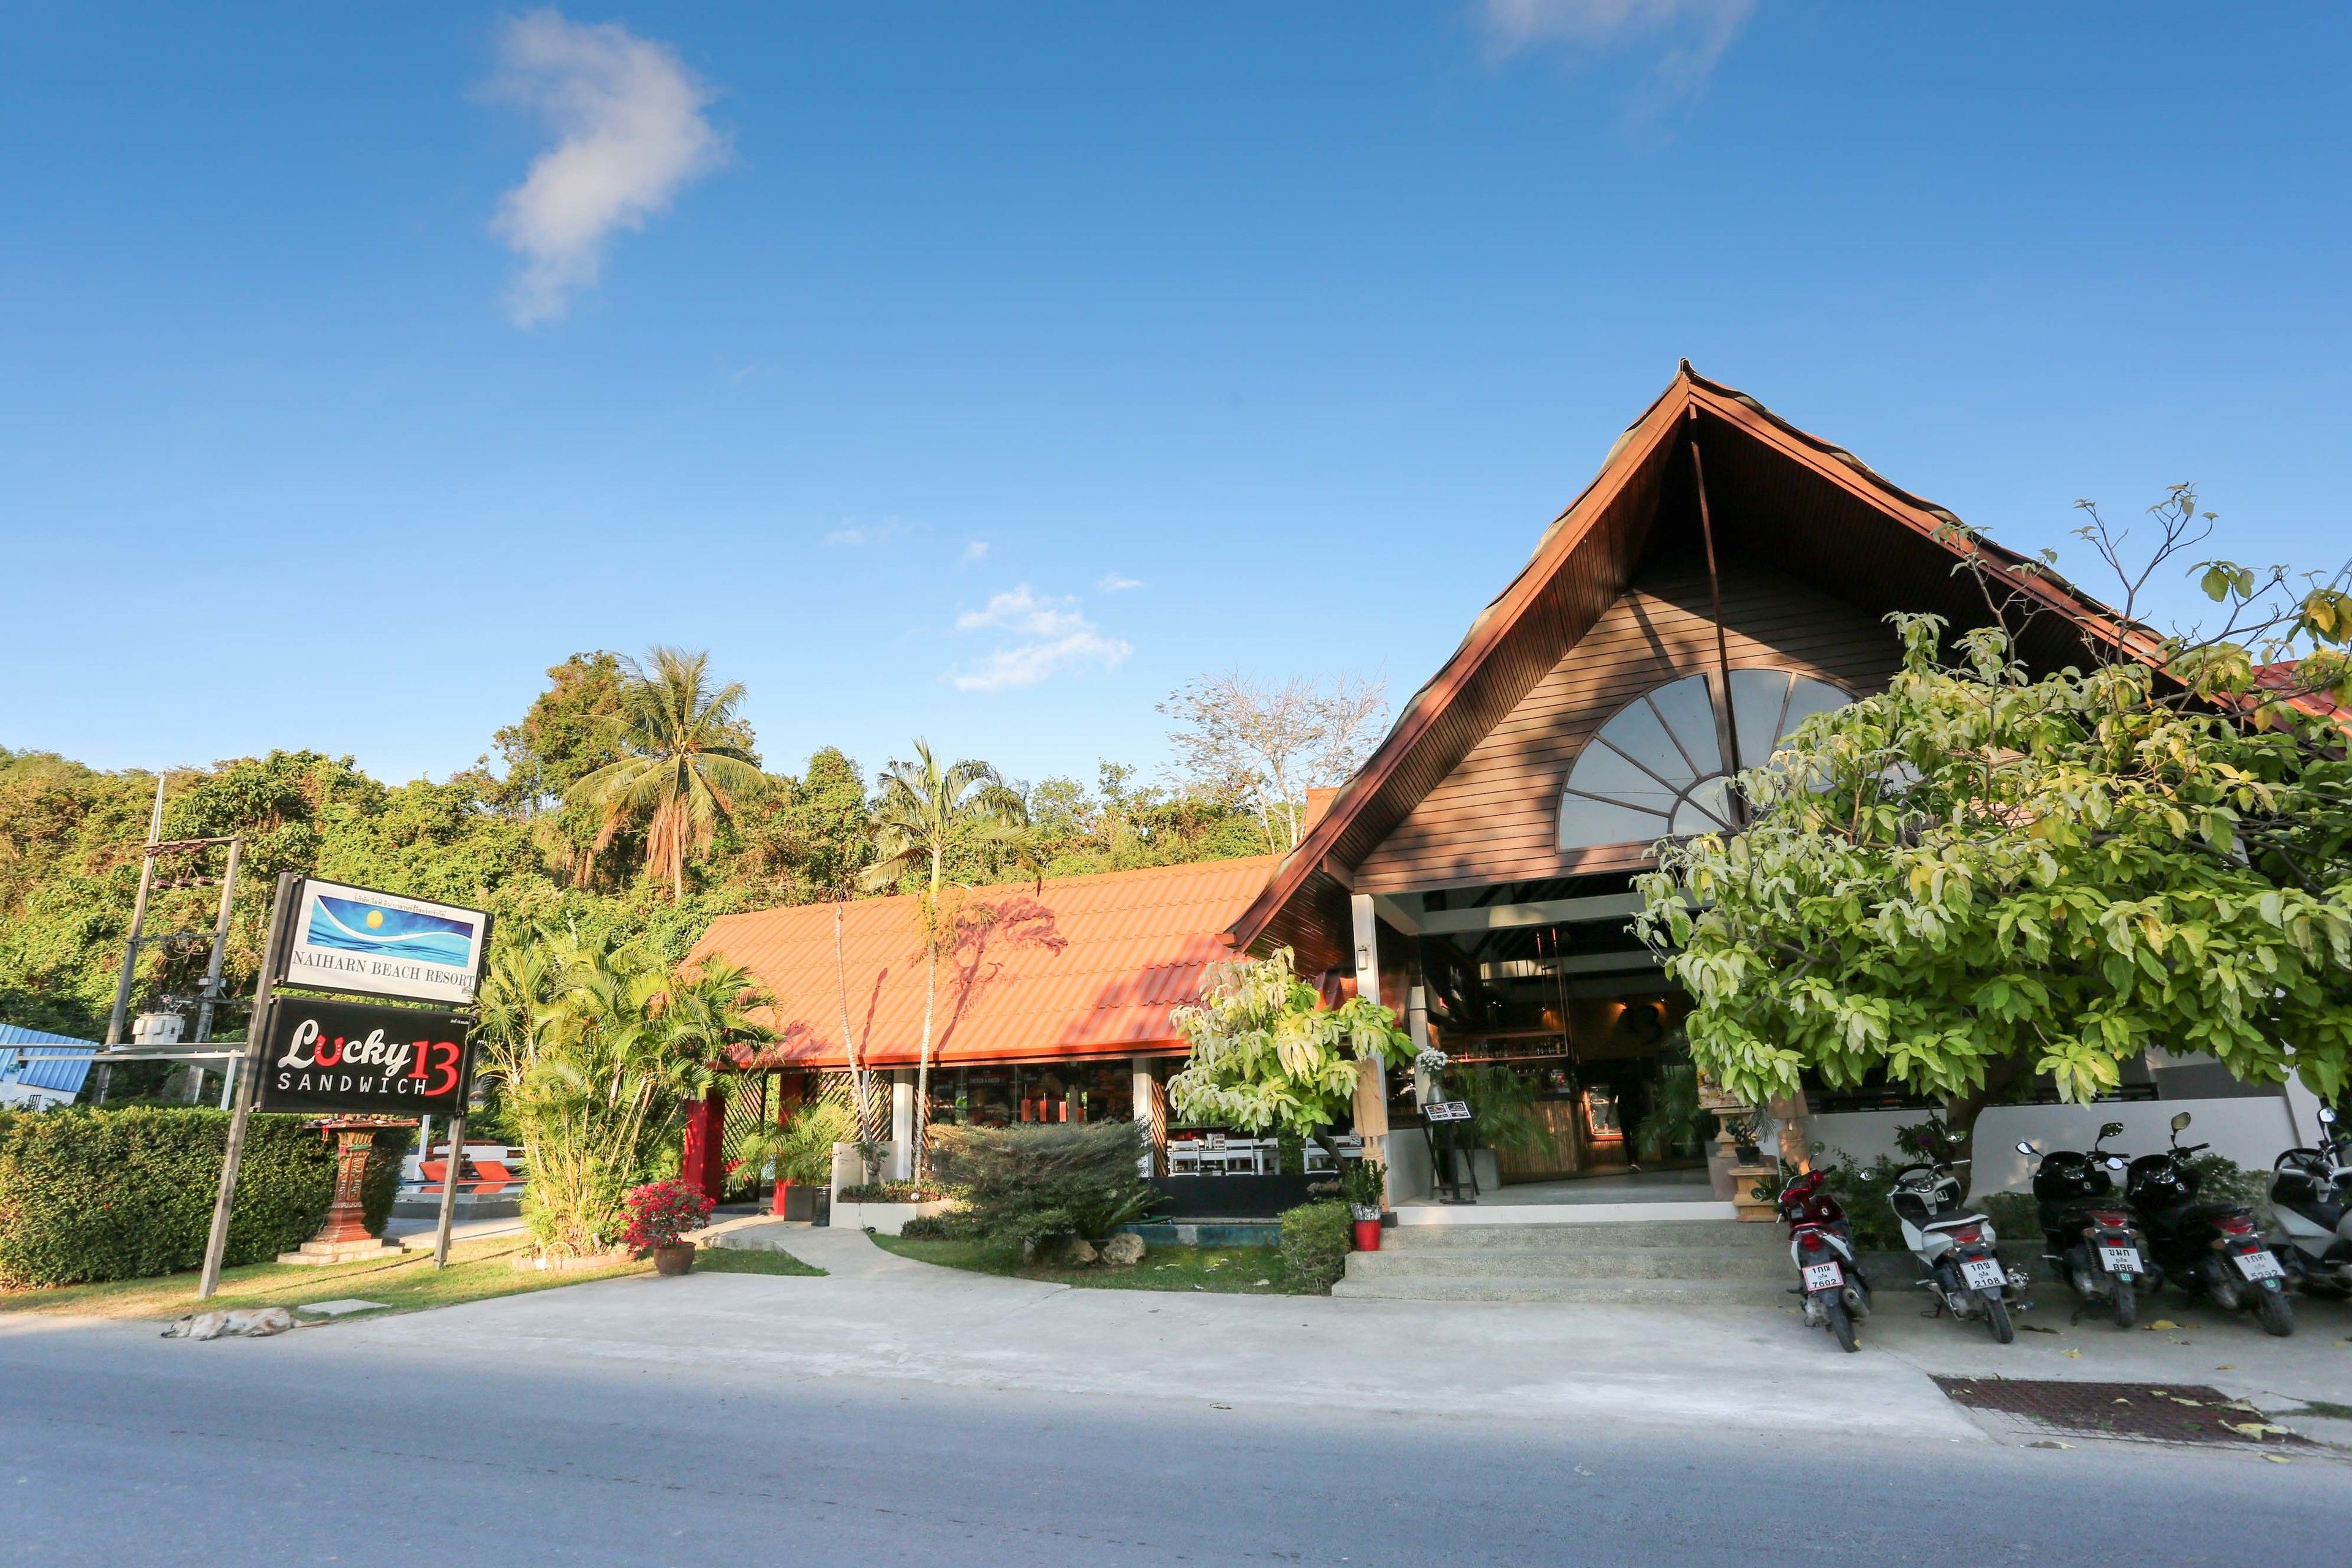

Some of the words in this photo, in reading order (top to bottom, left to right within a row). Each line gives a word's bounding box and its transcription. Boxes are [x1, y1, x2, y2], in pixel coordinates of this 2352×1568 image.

[292, 951, 366, 973] NAIHARN
[371, 961, 420, 980] BEACH
[426, 968, 475, 988] RESORT
[408, 1041, 459, 1096] 13
[277, 1072, 426, 1095] SANDWICH
[1812, 1278, 1838, 1288] 7602
[1975, 1277, 2000, 1287] 2108
